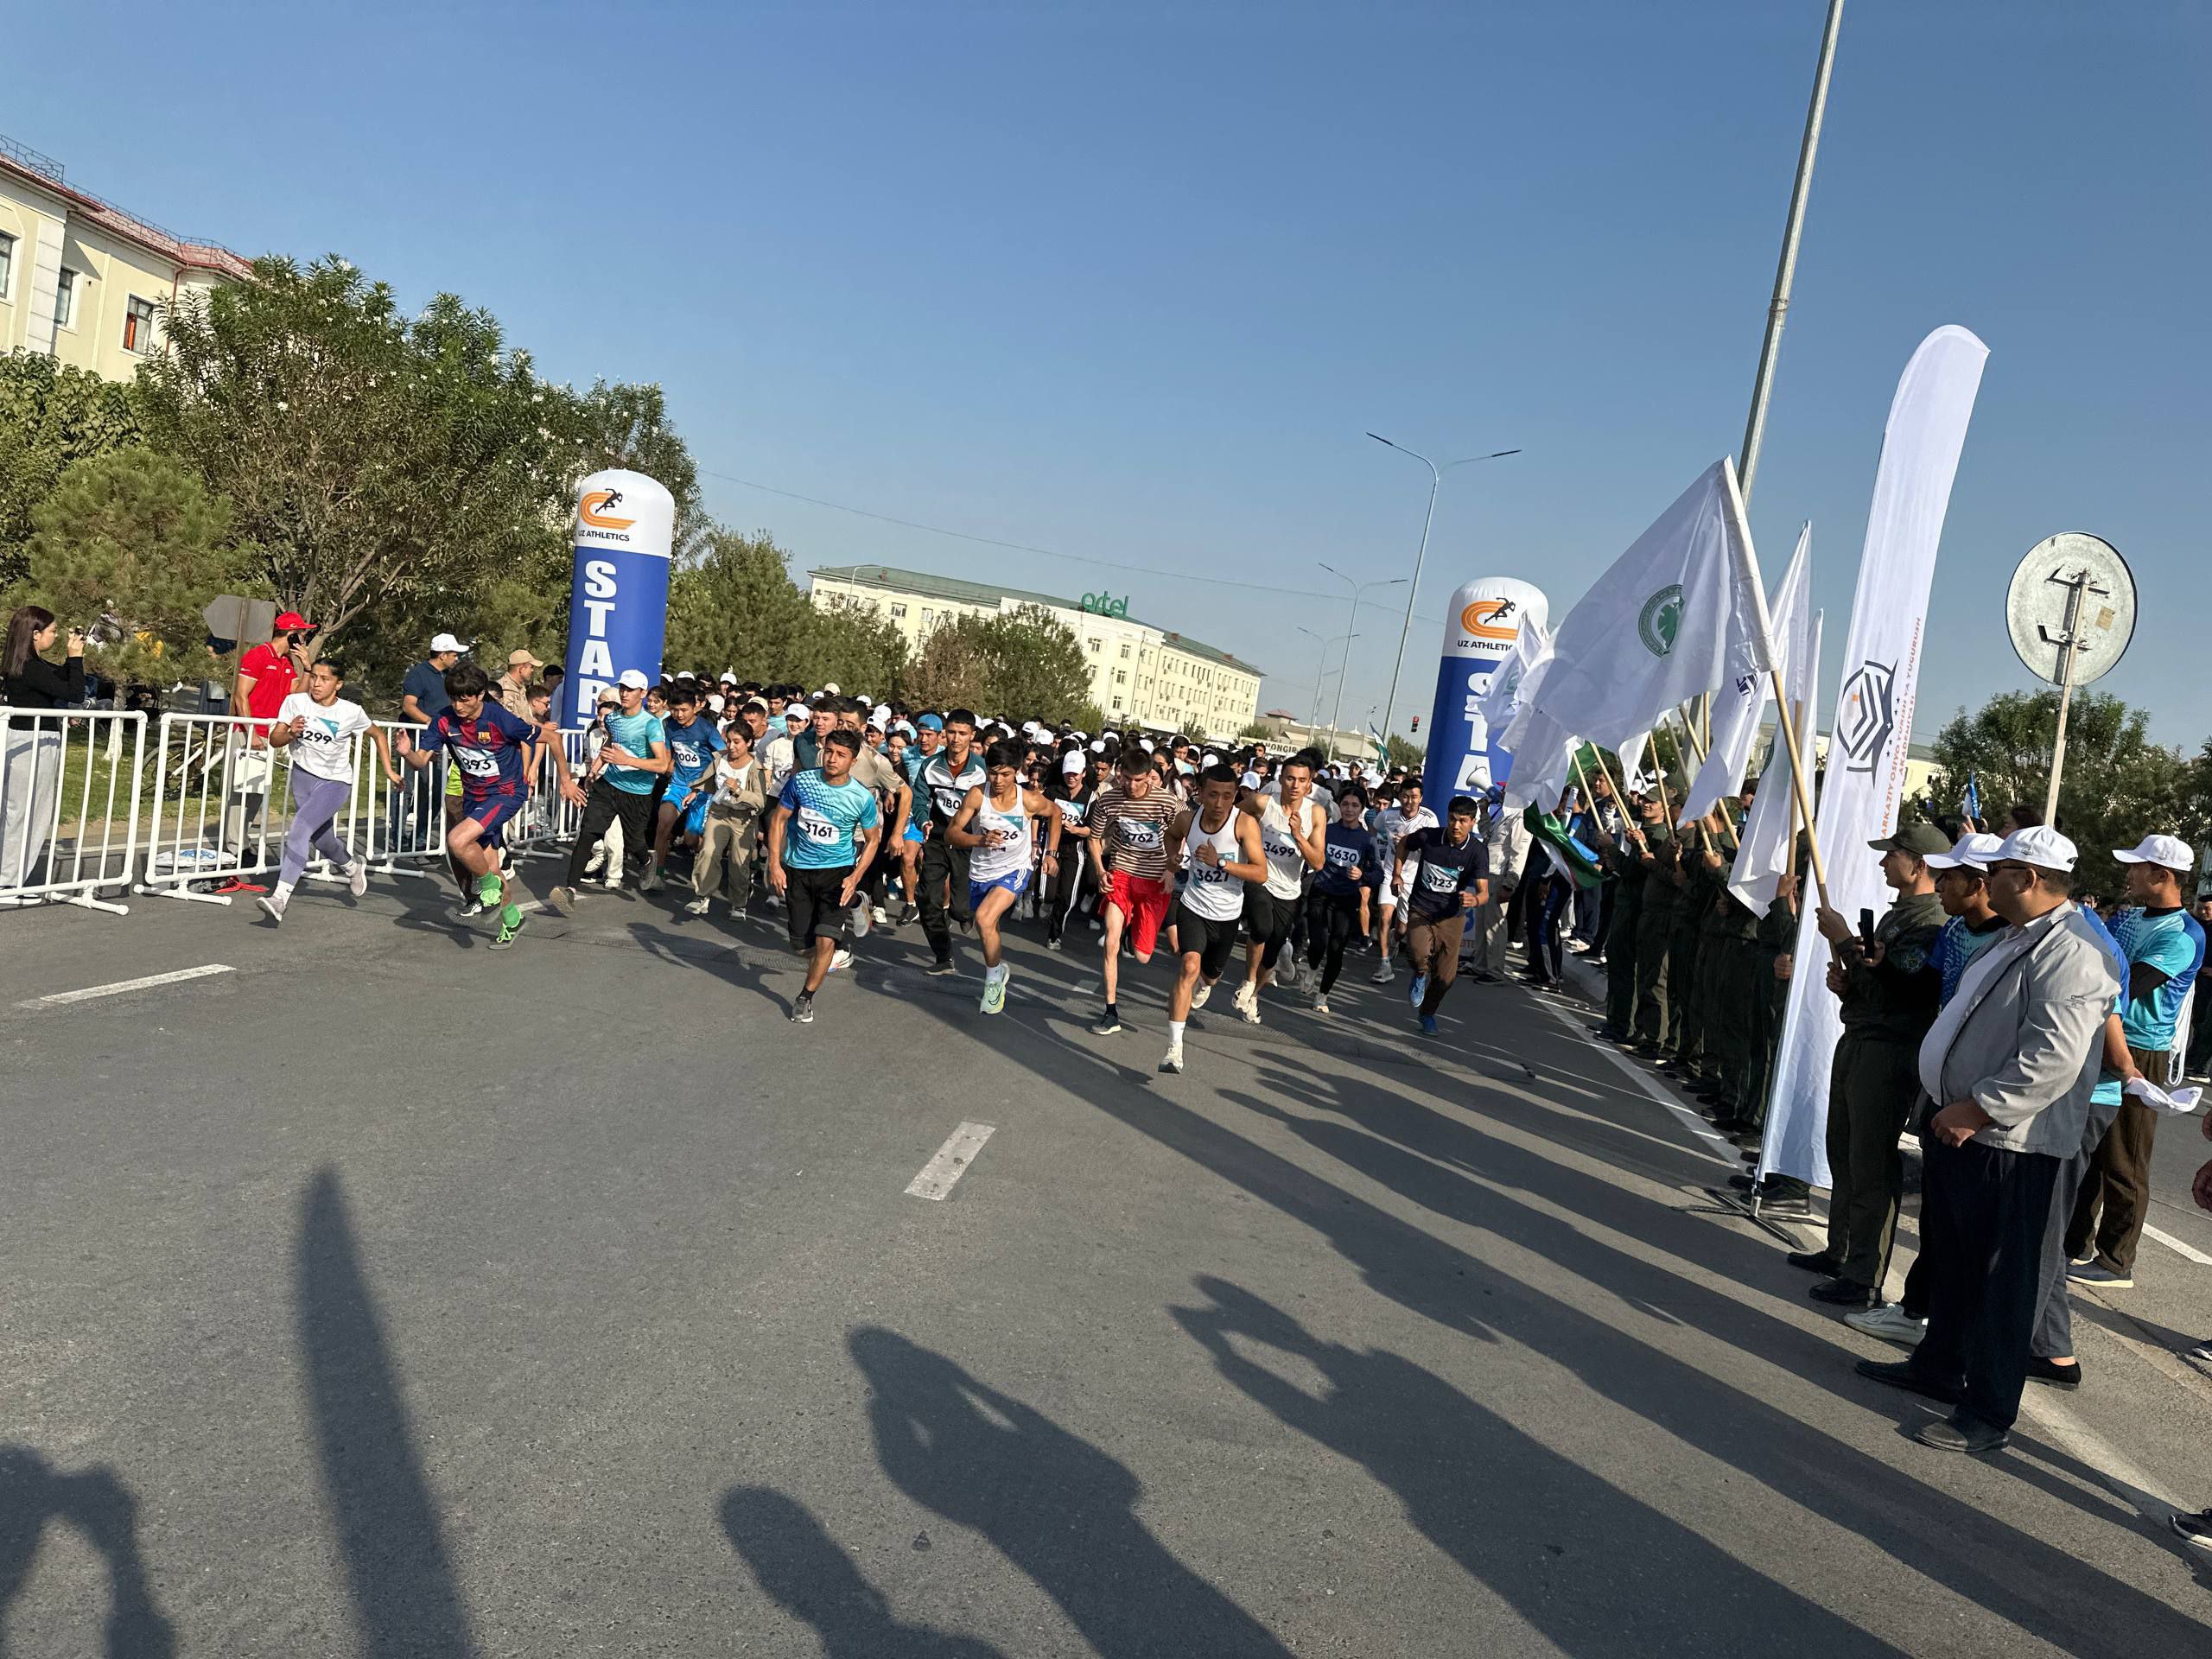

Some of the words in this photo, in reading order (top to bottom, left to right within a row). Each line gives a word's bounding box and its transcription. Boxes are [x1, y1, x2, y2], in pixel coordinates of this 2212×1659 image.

[586, 531, 630, 542] ATHLETICS
[1081, 590, 1129, 617] artel
[577, 560, 617, 730] STAR
[1891, 745, 1900, 781] OSIYO
[1907, 617, 1922, 679] YUGURUSH
[804, 822, 832, 837] 3161
[1263, 841, 1295, 857] 3499
[1328, 848, 1357, 863] 3630
[1196, 868, 1230, 882] 3627
